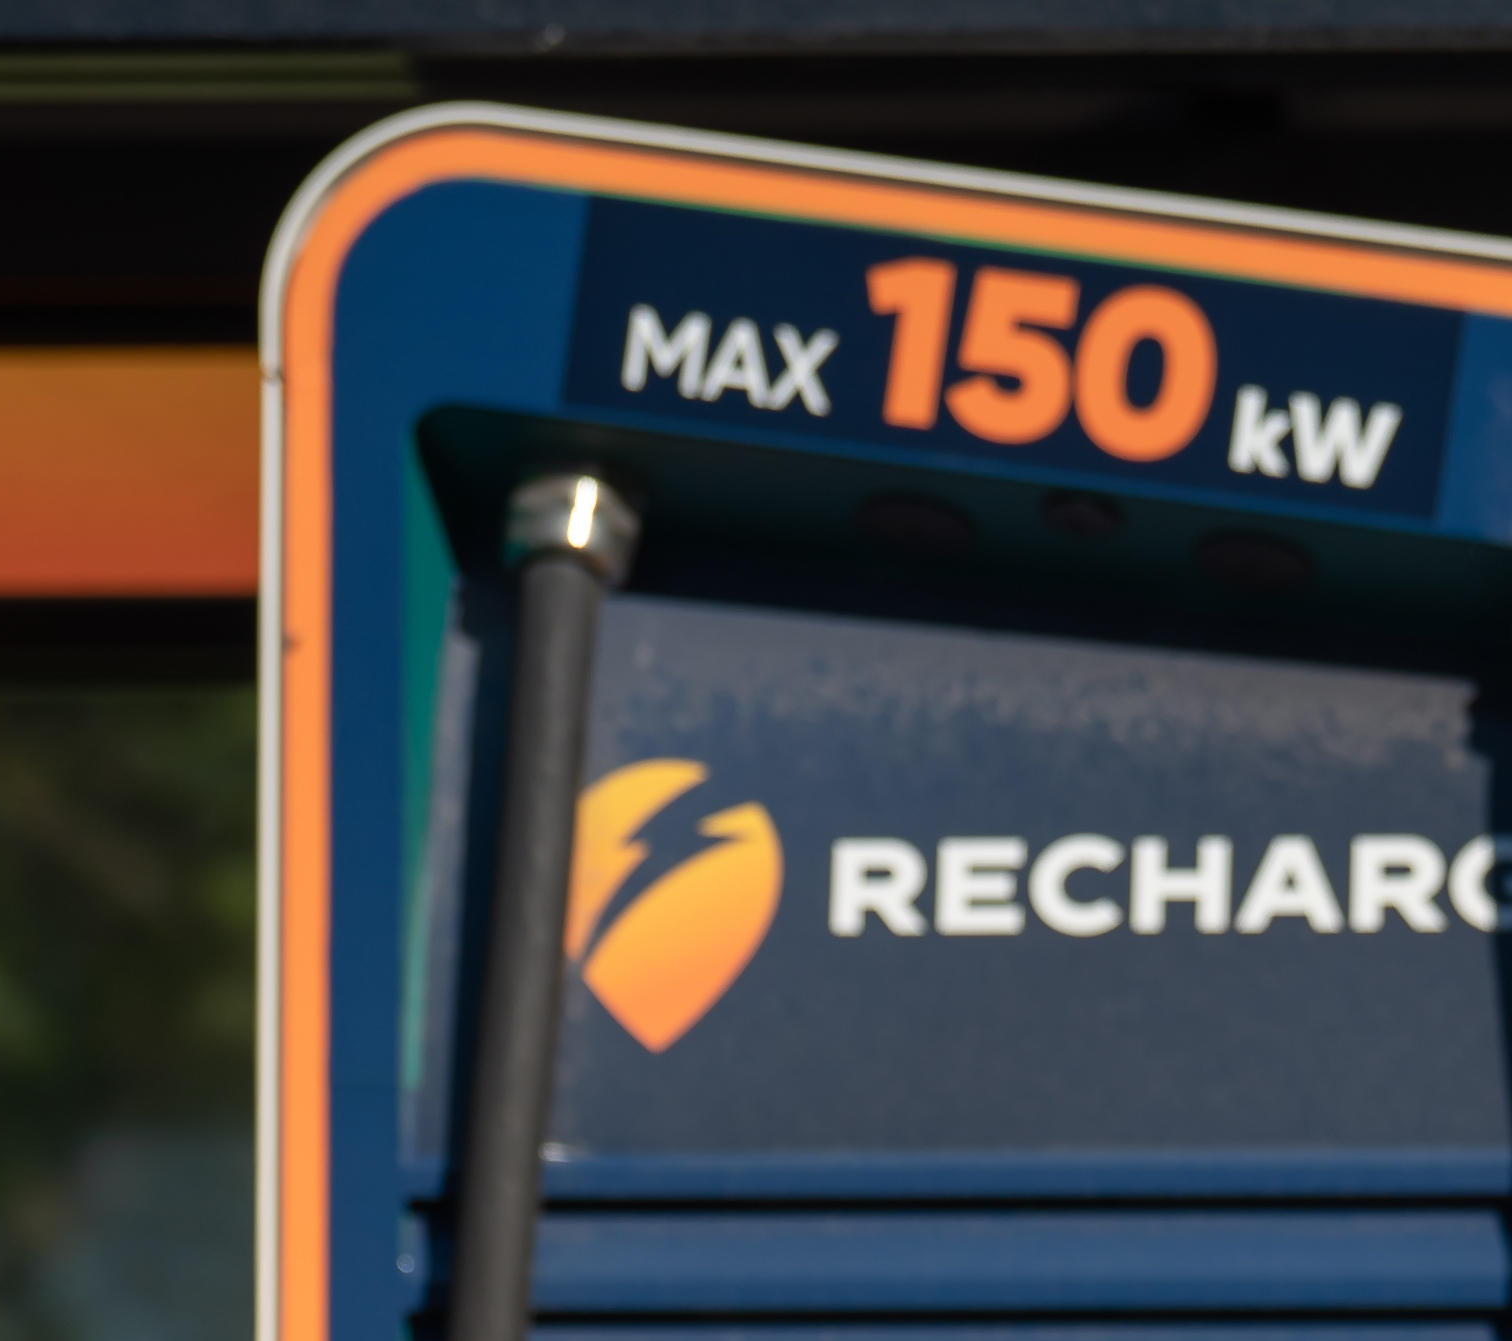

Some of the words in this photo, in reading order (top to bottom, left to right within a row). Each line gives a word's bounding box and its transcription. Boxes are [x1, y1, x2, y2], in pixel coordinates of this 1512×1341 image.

[622, 303, 841, 418] MAX
[864, 256, 1218, 463] 150
[1228, 384, 1404, 492] kW
